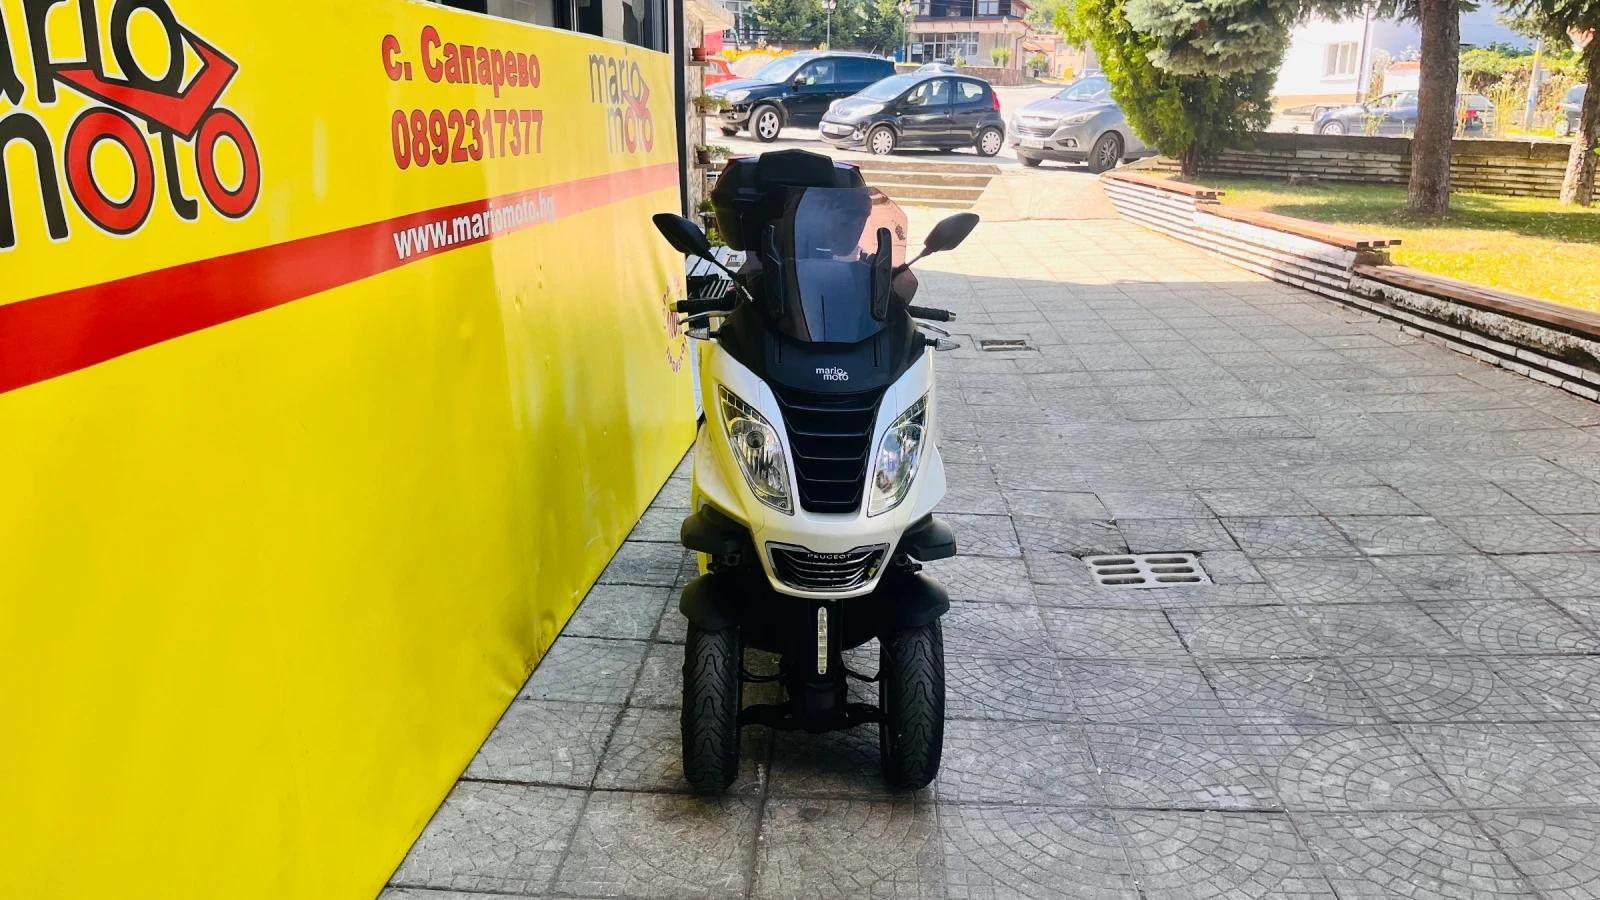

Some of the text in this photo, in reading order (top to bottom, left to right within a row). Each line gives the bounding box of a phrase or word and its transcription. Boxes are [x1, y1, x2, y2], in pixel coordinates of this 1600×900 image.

[382, 25, 540, 98] с. Сапарево
[588, 46, 641, 104] mario
[391, 108, 543, 170] 0892317377
[607, 106, 653, 154] moto
[393, 191, 554, 260] www.mariomoto.bg
[815, 366, 843, 374] mario
